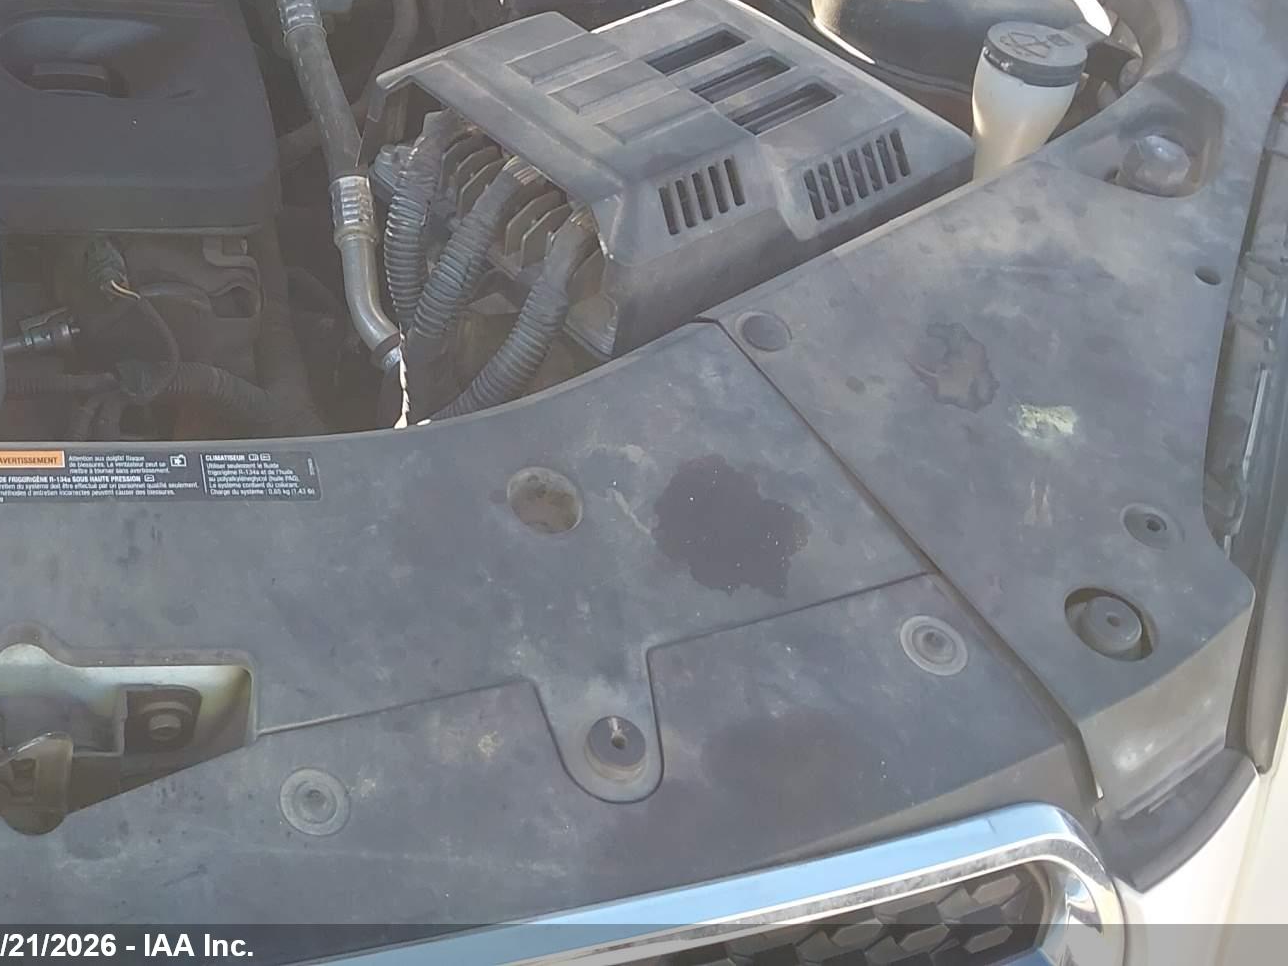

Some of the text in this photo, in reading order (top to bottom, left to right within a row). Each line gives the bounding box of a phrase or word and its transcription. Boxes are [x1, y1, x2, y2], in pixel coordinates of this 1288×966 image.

[49, 475, 71, 483] R-134a
[72, 475, 88, 483] SOUS
[90, 475, 109, 483] HAUTE
[110, 475, 141, 483] PRESSION
